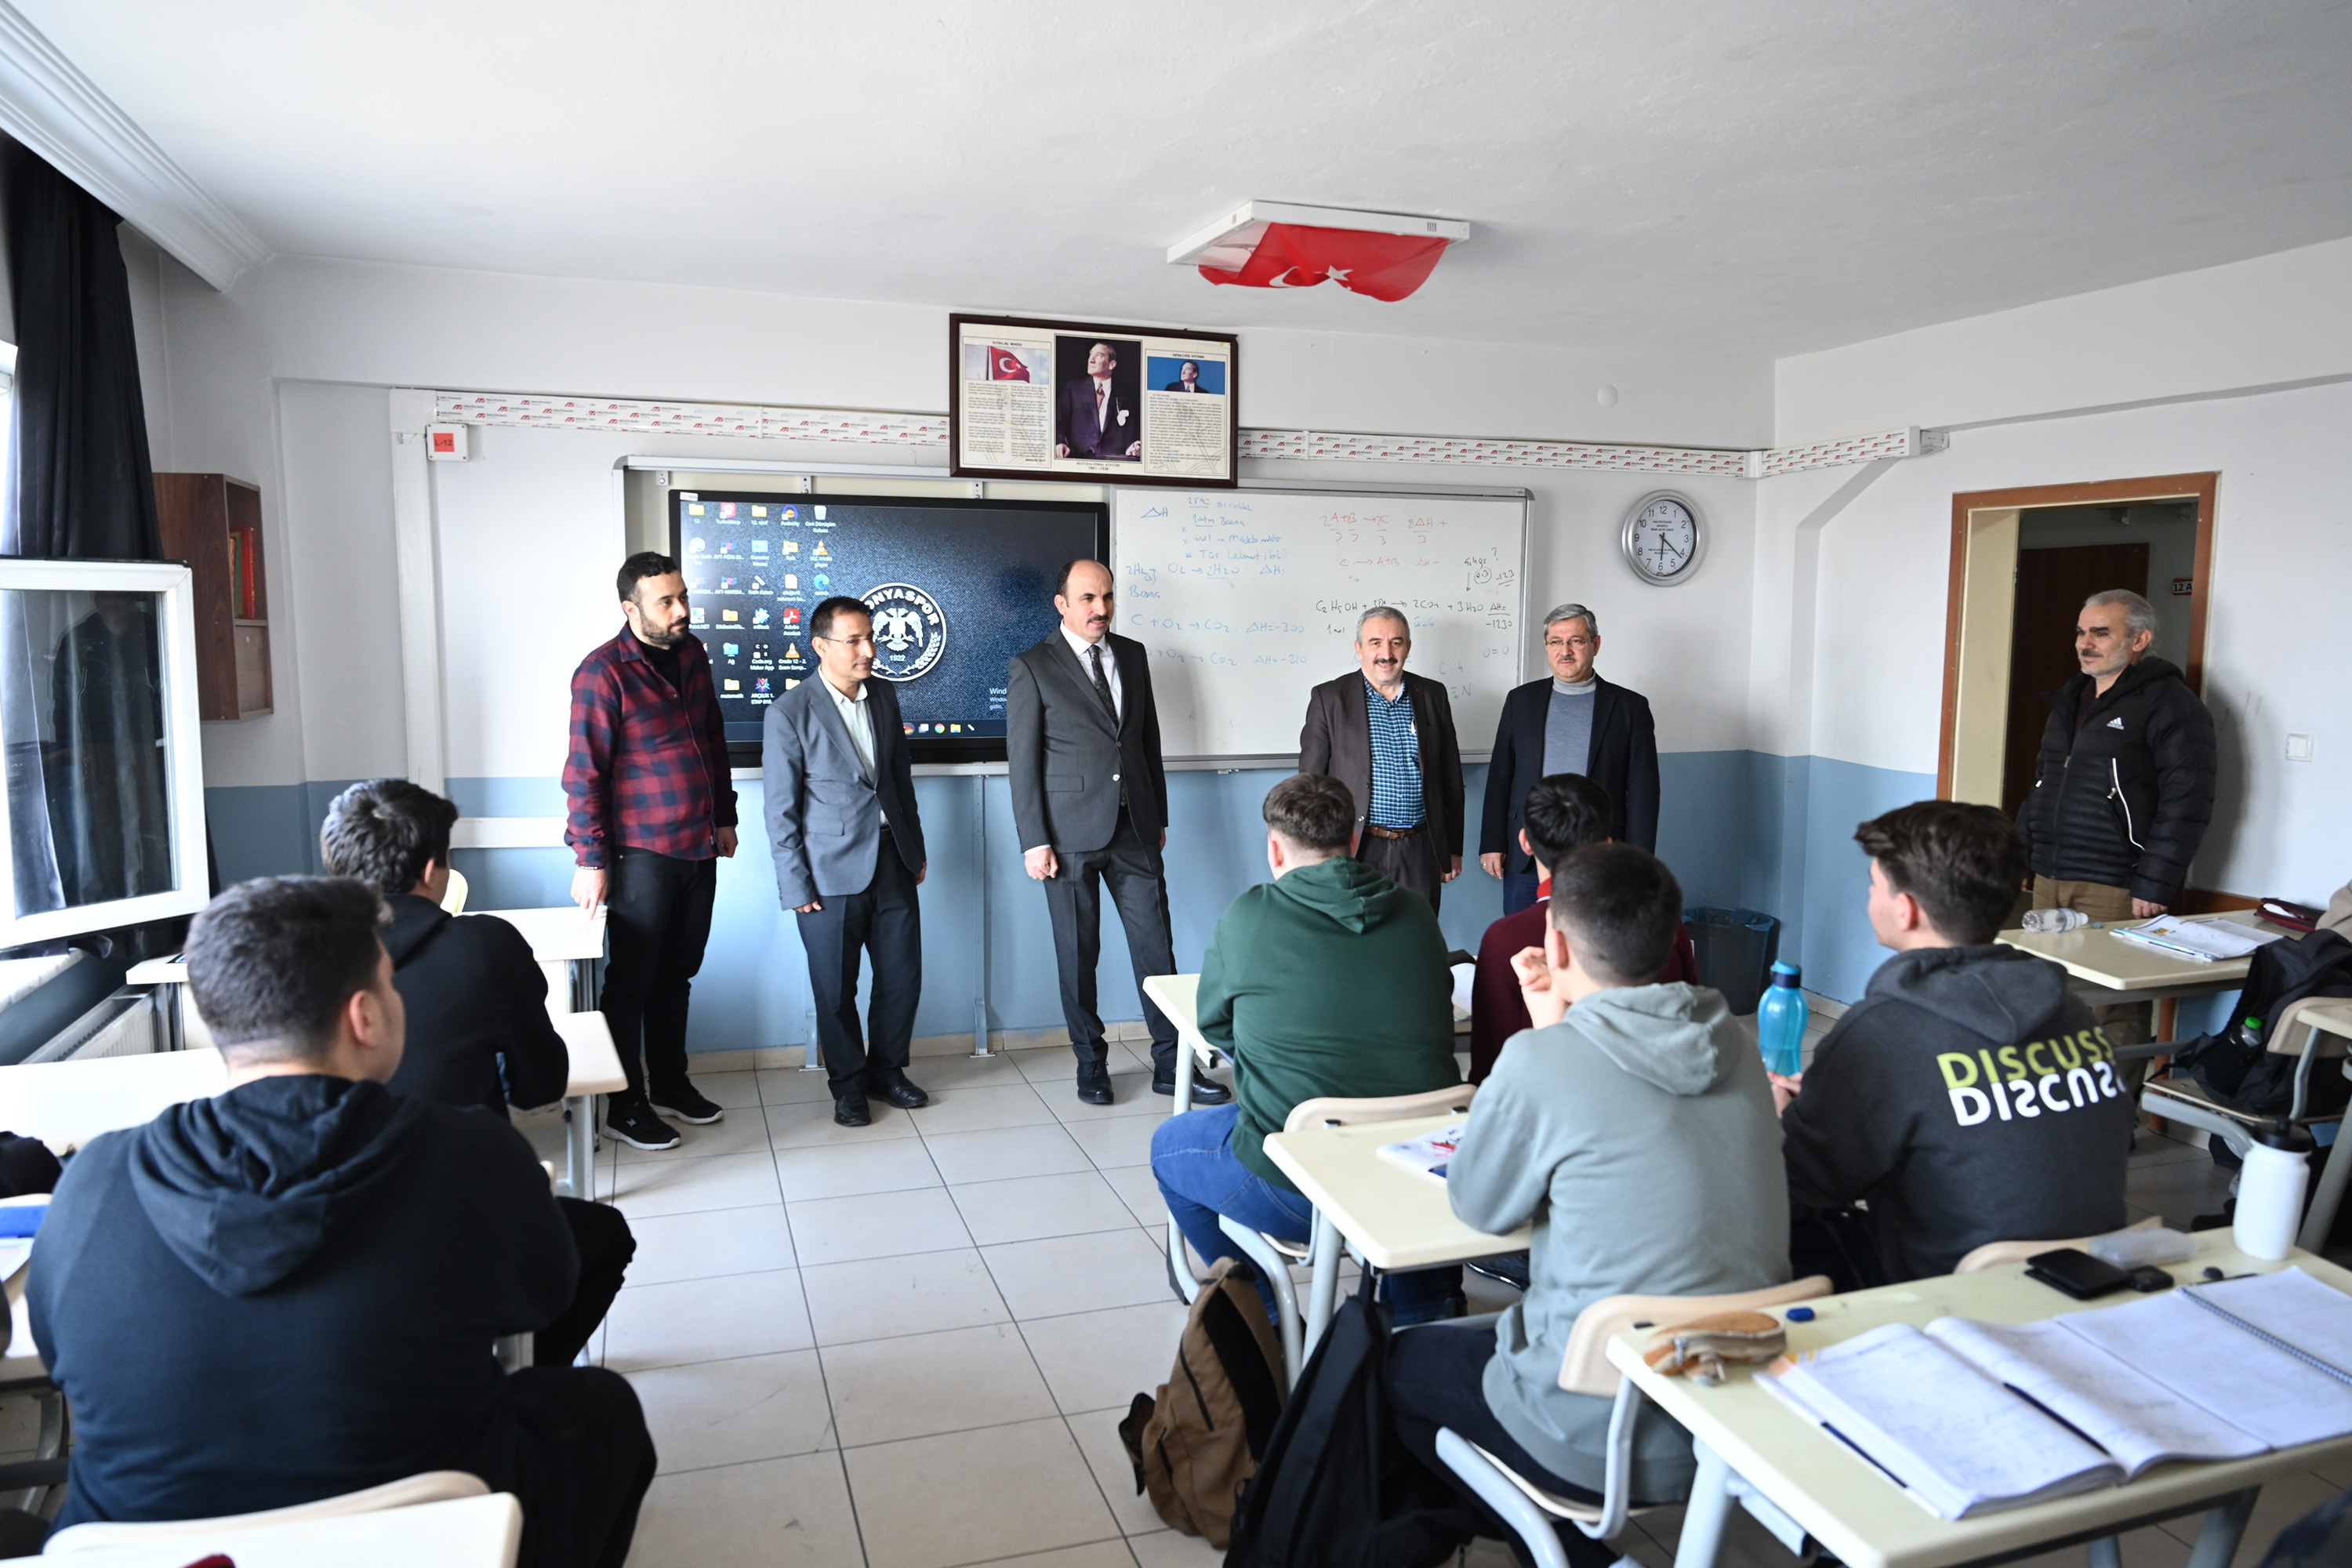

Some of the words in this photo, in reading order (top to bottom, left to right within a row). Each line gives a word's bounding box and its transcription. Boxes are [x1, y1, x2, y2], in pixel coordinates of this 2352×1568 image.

[1648, 509, 1654, 517] 11
[1659, 506, 1668, 514] 12
[1639, 519, 1646, 528] 10
[1681, 520, 1686, 528] 2
[1635, 533, 1639, 542] 9
[1638, 547, 1642, 556] 8
[1680, 548, 1685, 557] 4
[1646, 558, 1651, 567] 7
[1658, 562, 1663, 571] 6
[2173, 583, 2184, 592] 12
[2186, 583, 2193, 591] A
[864, 588, 940, 626] ONYASPOR
[1936, 1026, 2115, 1090] DISCUSS
